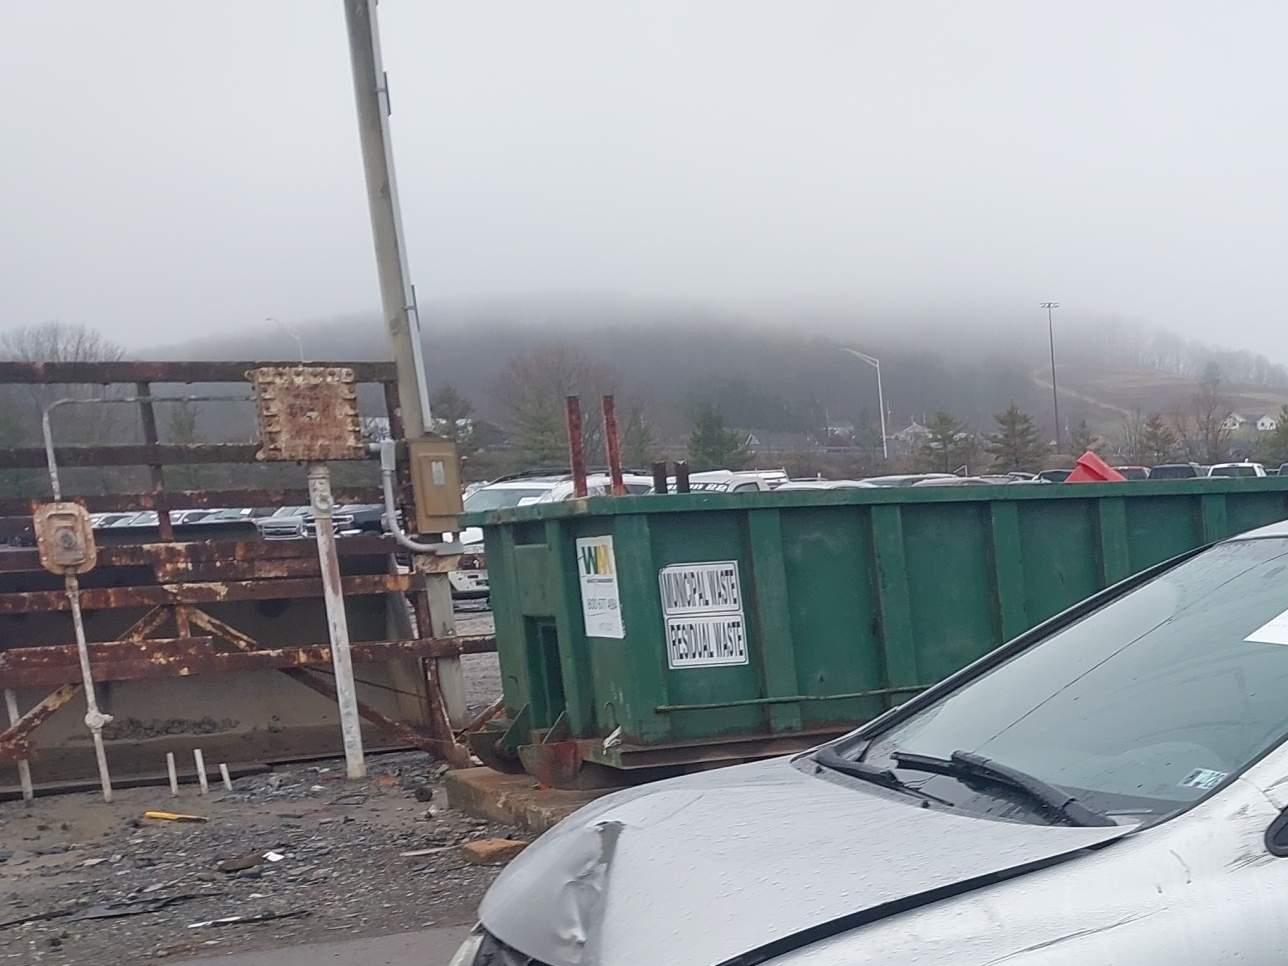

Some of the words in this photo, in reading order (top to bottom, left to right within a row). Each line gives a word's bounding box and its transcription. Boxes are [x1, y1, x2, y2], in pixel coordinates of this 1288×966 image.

[663, 572, 709, 608] MUNICIPAL
[707, 569, 738, 605] WASTE
[670, 624, 714, 661] RESIDUAL
[713, 621, 744, 658] WASTE
